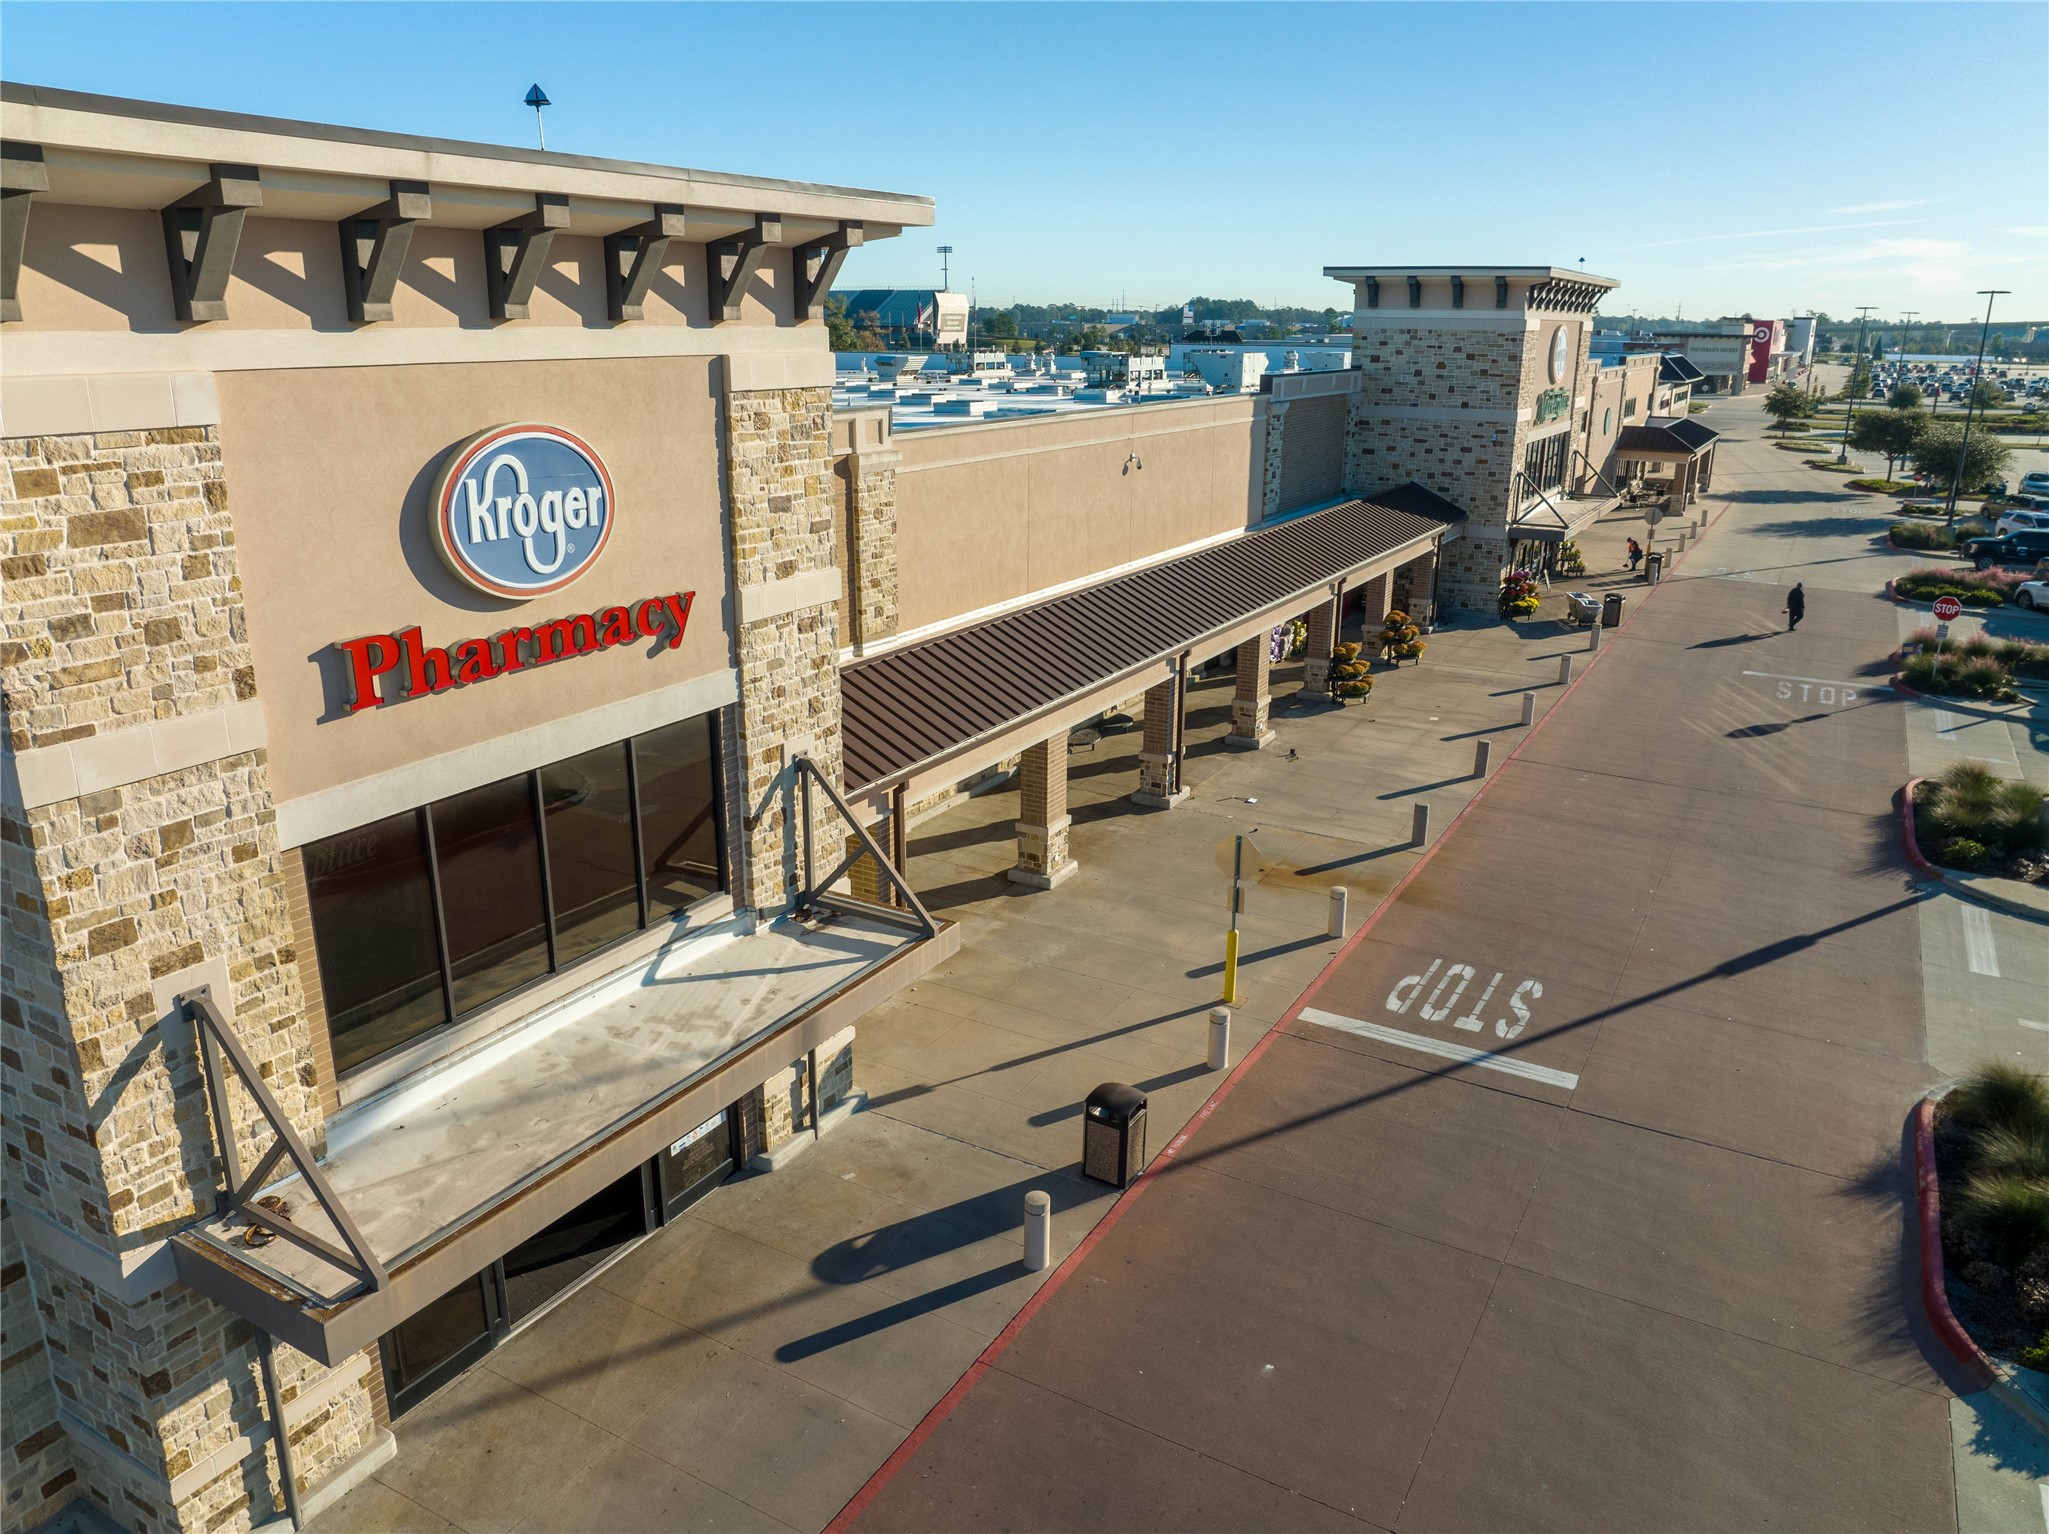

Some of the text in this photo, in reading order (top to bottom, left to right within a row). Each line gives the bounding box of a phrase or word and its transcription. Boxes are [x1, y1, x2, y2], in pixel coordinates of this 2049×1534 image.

[464, 454, 602, 575] Kroger
[1934, 603, 1960, 615] STOP
[338, 590, 697, 713] Pharmacy
[1776, 681, 1857, 707] STOP
[1385, 958, 1544, 1040] STOP
